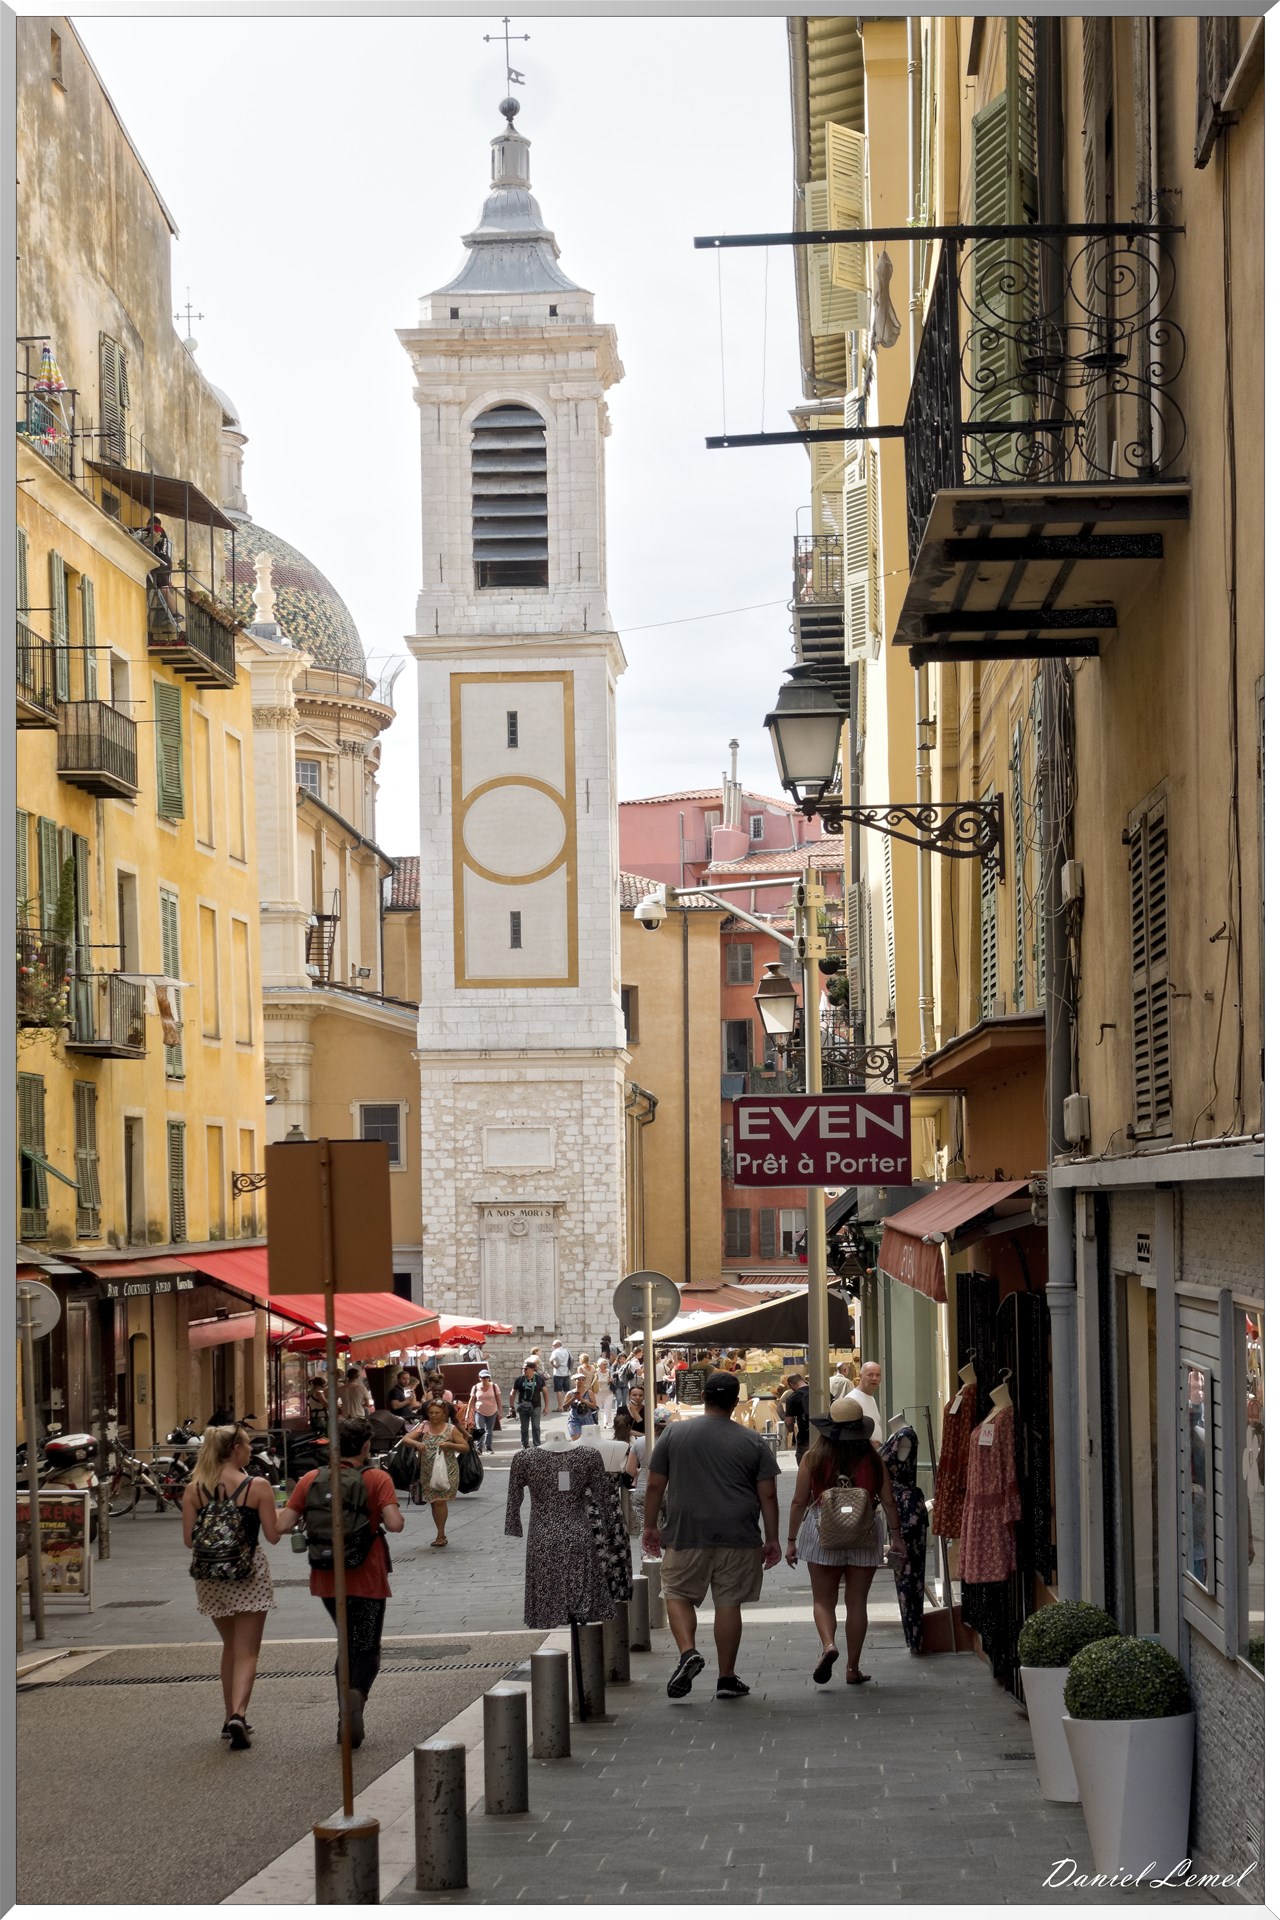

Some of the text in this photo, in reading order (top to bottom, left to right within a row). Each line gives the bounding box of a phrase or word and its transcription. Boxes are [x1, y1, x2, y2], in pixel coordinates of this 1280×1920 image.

[738, 1103, 904, 1141] EVEN
[736, 1151, 908, 1175] Prêt à Porter
[496, 1209, 516, 1217] NOS
